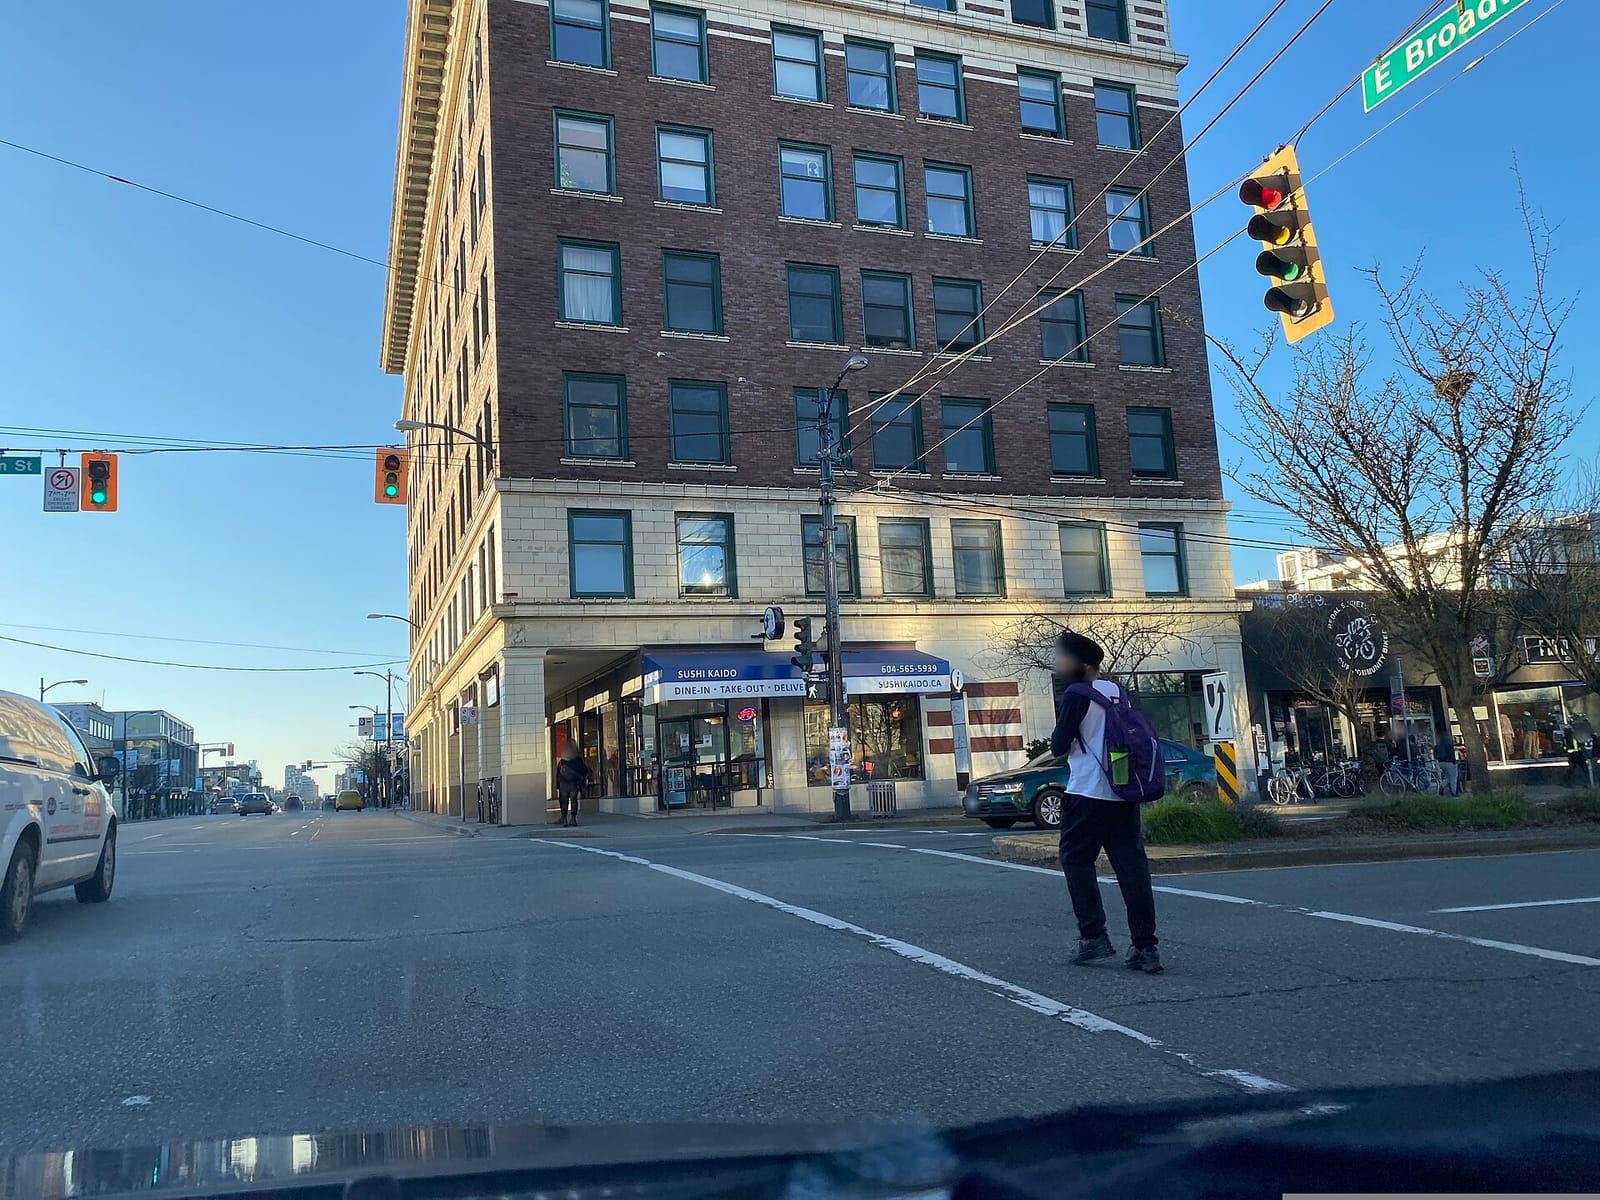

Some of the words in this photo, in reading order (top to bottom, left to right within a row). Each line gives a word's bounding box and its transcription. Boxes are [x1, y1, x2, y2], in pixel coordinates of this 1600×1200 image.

[1374, 60, 1393, 95] E
[1405, 0, 1511, 73] Broad
[15, 459, 33, 471] St
[881, 664, 938, 673] 604-565-5939
[1351, 653, 1387, 677] OMMUNITY
[678, 670, 706, 679] SUSHI
[707, 669, 737, 678] KAIDO
[878, 679, 942, 688] SUSHIKAIDO.CA
[674, 686, 711, 695] DINE-IN
[719, 685, 742, 694] TAKE
[745, 684, 765, 693] OUT
